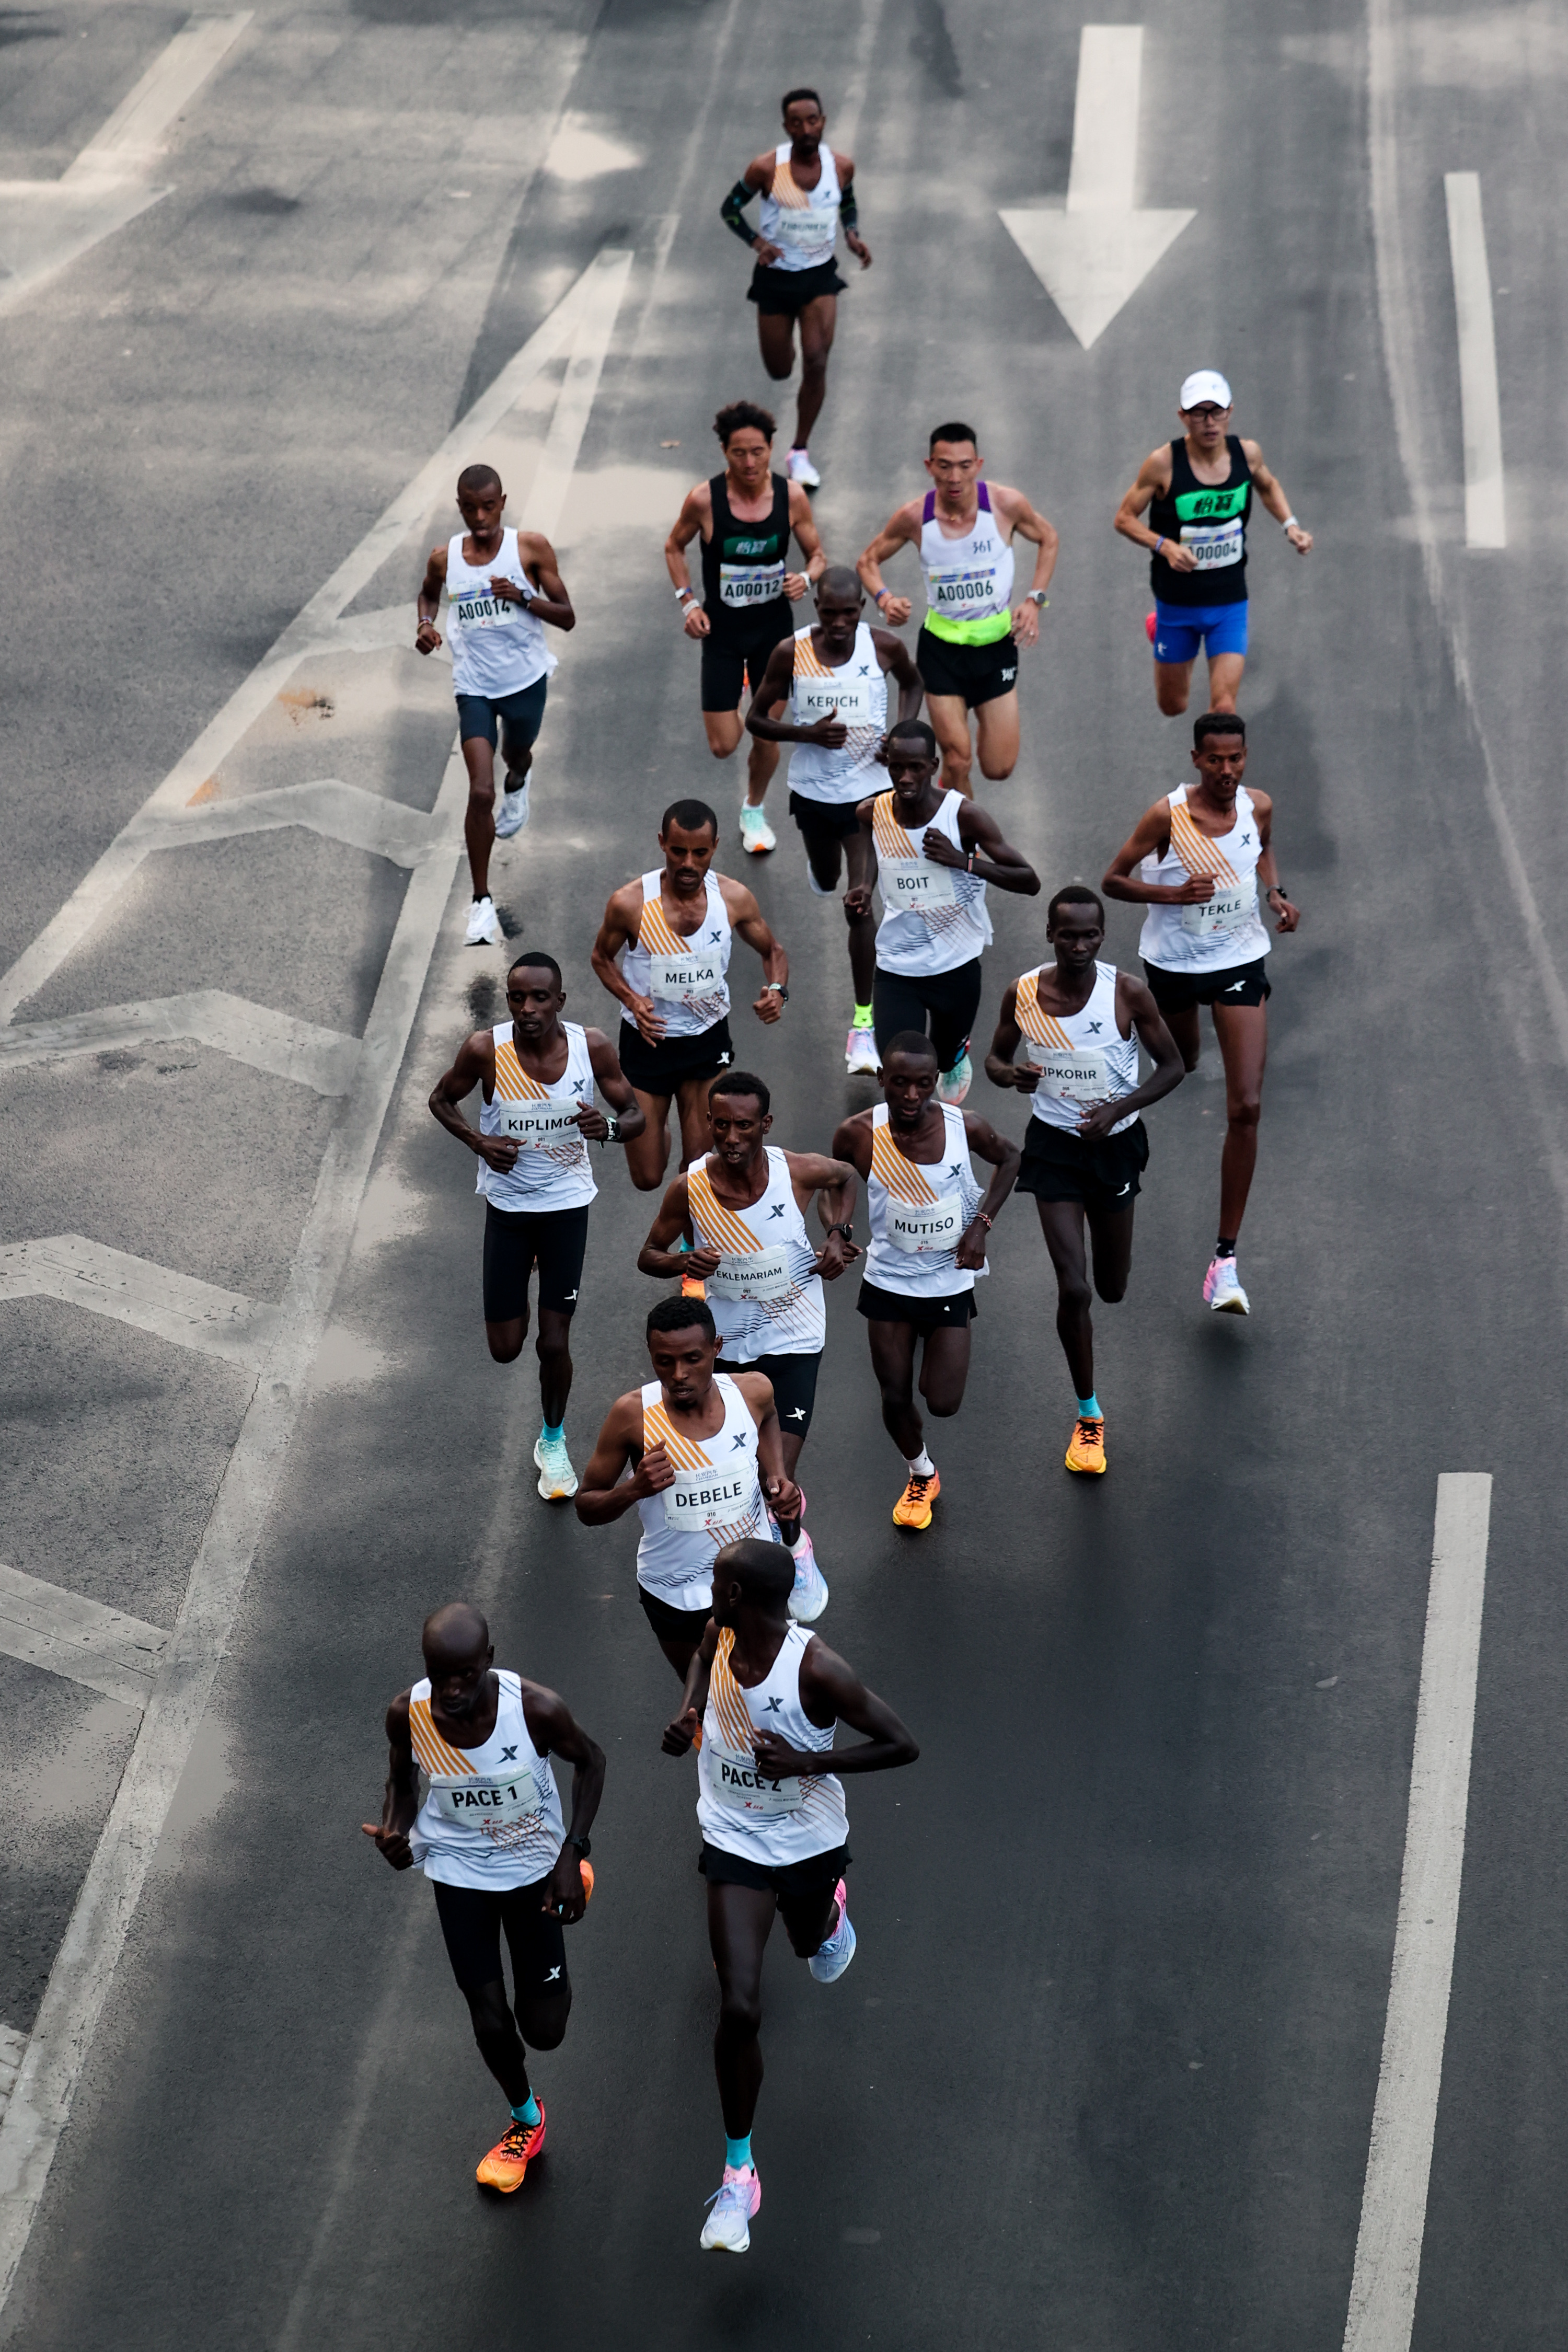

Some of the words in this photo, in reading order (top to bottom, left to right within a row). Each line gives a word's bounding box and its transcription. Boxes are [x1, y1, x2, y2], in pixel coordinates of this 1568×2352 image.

[1189, 540, 1237, 560] 00004
[725, 580, 780, 598] A00012
[937, 580, 993, 602] A00006
[458, 601, 511, 621] A00014
[807, 695, 859, 708] KERICH
[897, 877, 929, 890] BOIT
[1198, 899, 1241, 917] TEKLE
[665, 969, 714, 984] MELKA
[1043, 1066, 1097, 1080] IPKORIR
[508, 1115, 574, 1132] KIPLIMO
[895, 1217, 954, 1234] MUTISO
[713, 1266, 782, 1281] EKLEMARIAM
[675, 1481, 742, 1507] DEBELE
[721, 1762, 766, 1790] PACE
[451, 1790, 503, 1808] PACE
[507, 1785, 517, 1801] 1
